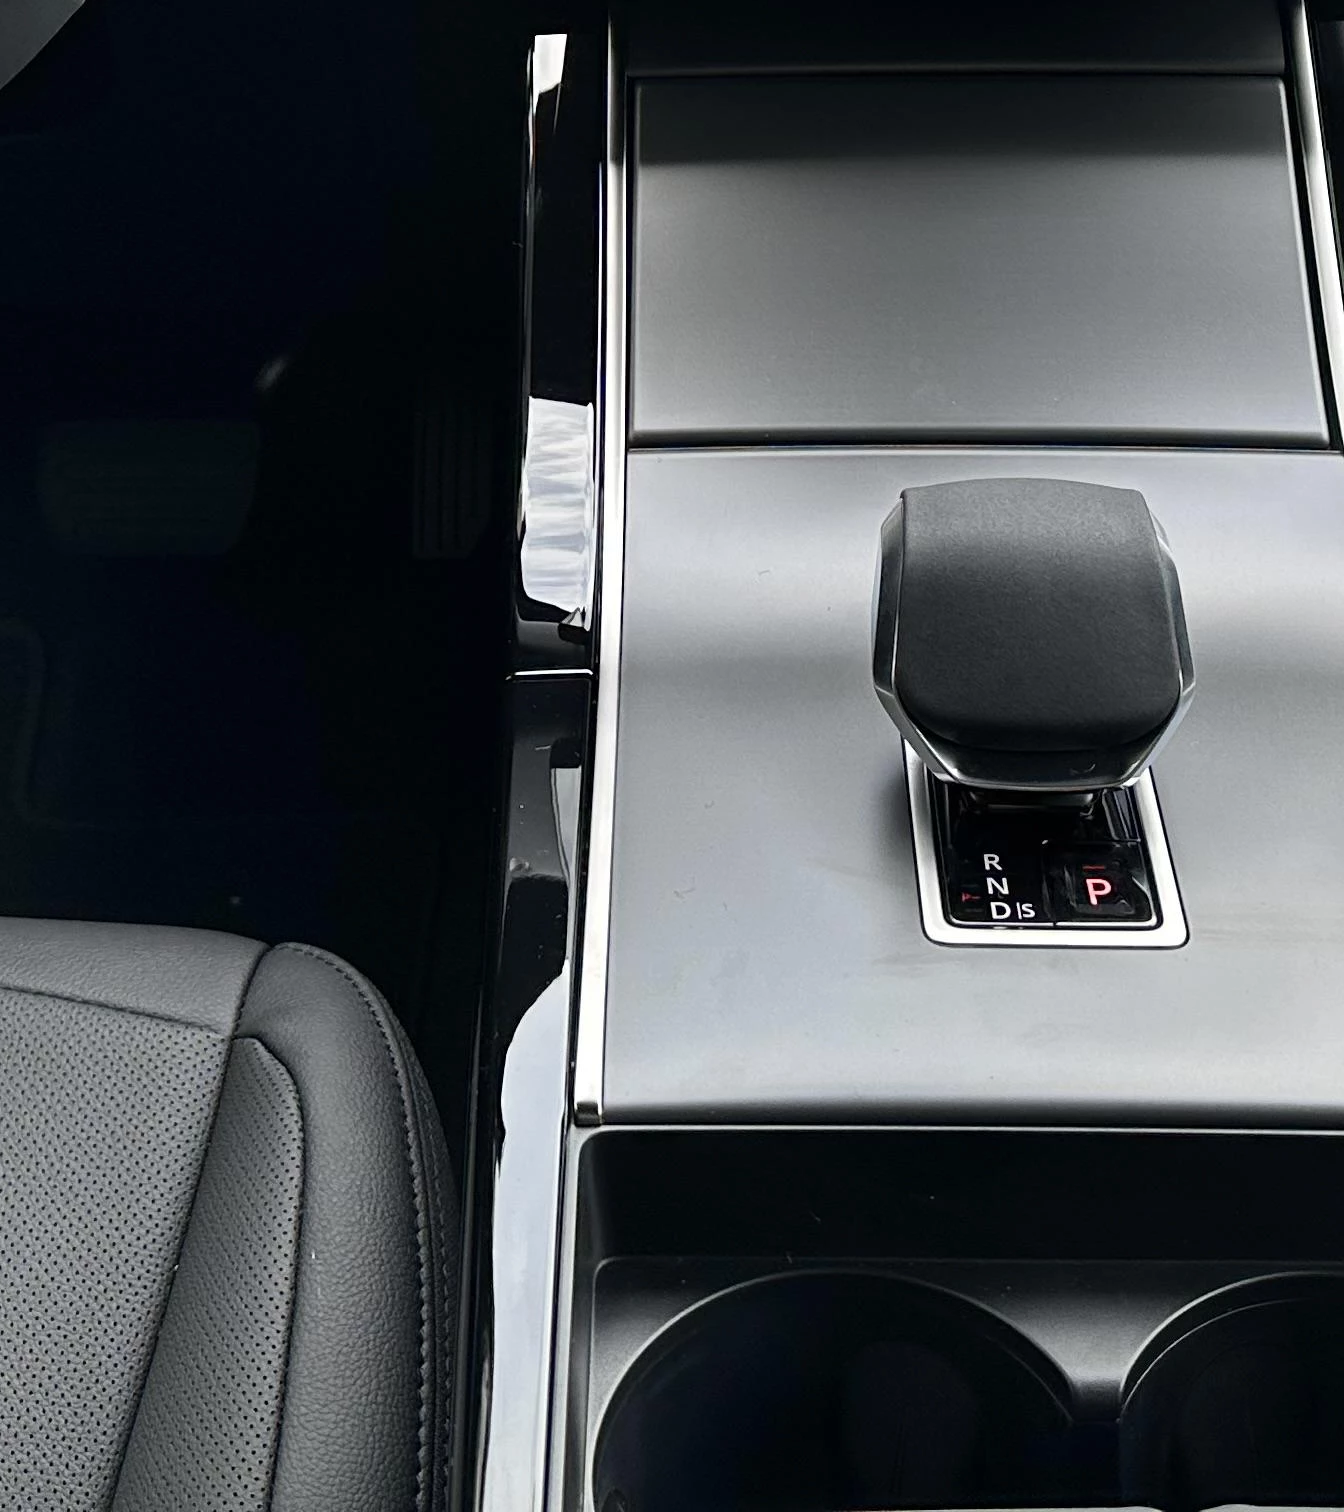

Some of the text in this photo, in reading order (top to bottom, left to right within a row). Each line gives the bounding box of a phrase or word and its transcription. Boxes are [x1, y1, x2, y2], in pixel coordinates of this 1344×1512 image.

[983, 853, 1003, 871] R
[986, 876, 1009, 895] N
[1085, 878, 1112, 906] P
[990, 901, 1012, 920] D
